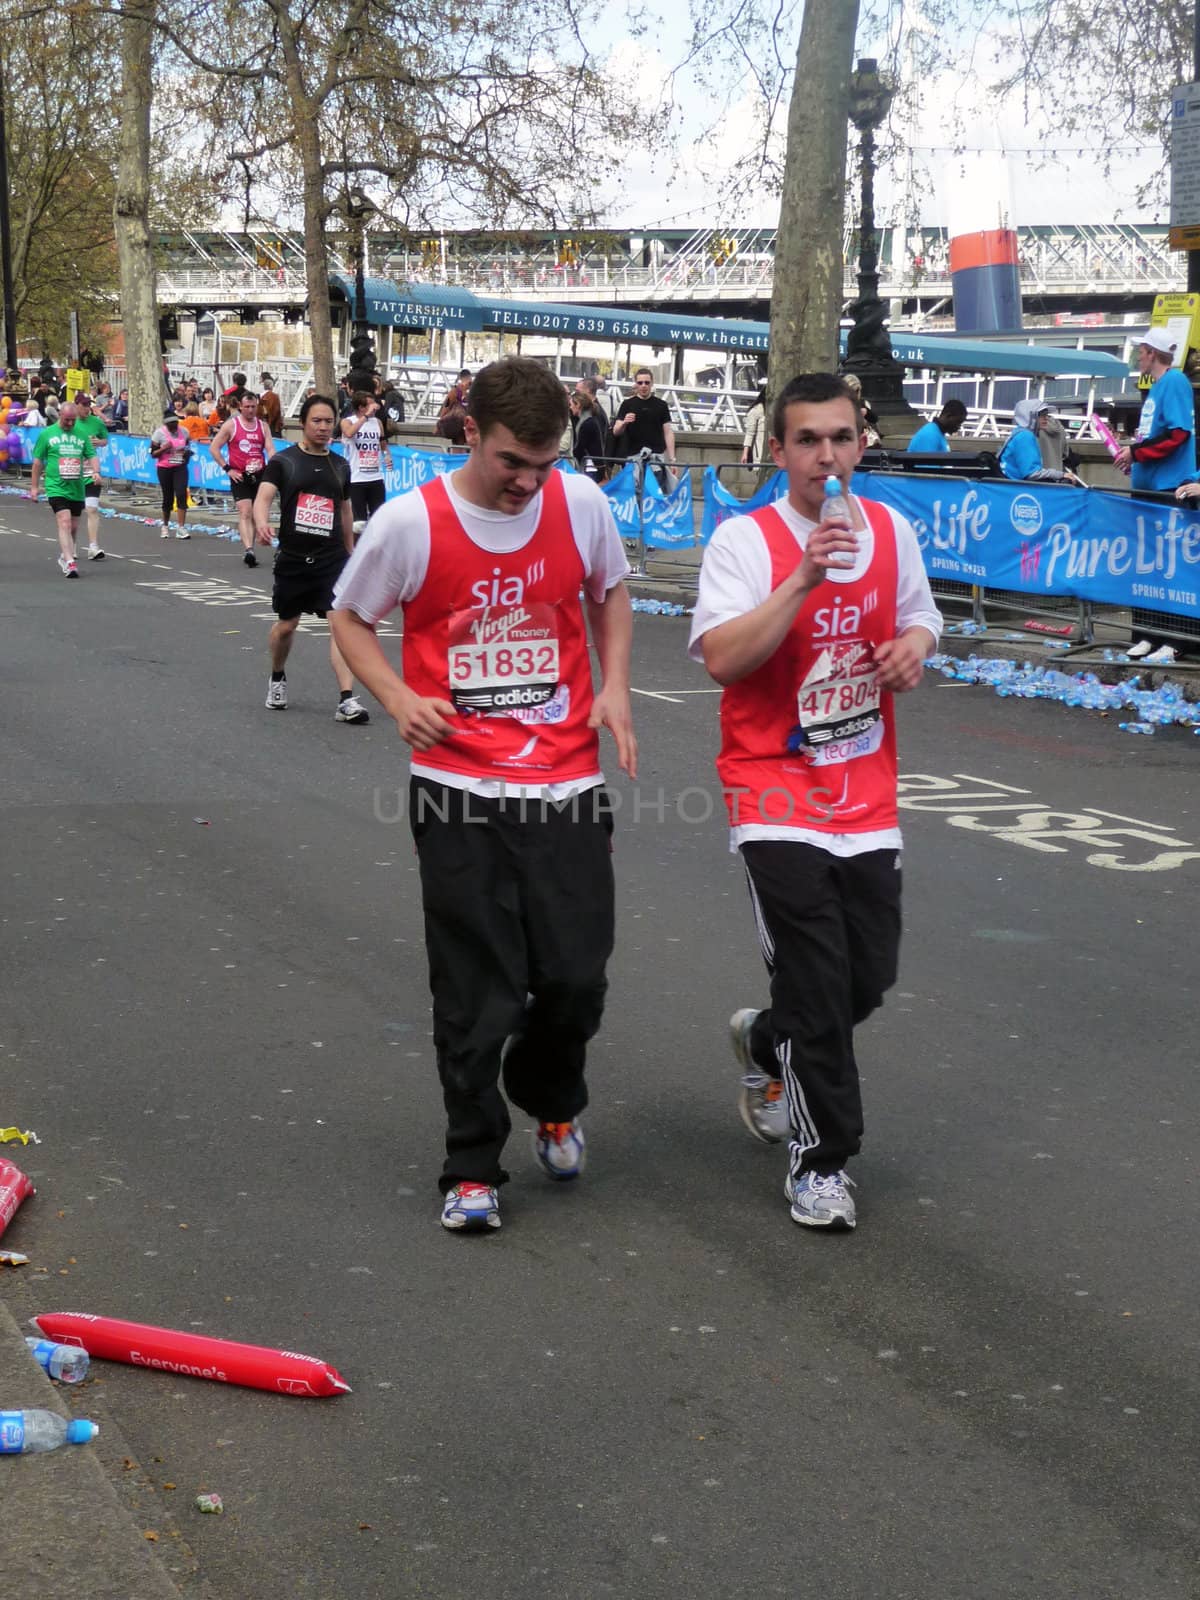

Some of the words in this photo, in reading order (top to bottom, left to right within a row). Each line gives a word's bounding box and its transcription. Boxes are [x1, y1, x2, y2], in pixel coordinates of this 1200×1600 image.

[373, 300, 465, 318] TATTERSHALL
[393, 313, 444, 327] CASTLE
[492, 310, 528, 326] TEL:
[532, 315, 570, 329] 0207
[577, 318, 605, 332] 839
[612, 322, 649, 336] 6548
[49, 433, 85, 448] MARK
[402, 452, 427, 490] Life
[932, 489, 992, 555] Life
[1046, 523, 1132, 587] Pure
[1135, 508, 1200, 580] Life
[932, 556, 960, 571] SPRING
[470, 567, 524, 609] sia
[1132, 583, 1165, 599] SPRING
[1168, 589, 1197, 606] WATER
[469, 606, 532, 645] Virgin
[811, 596, 861, 638] sia
[511, 628, 550, 638] money
[453, 646, 556, 681] 51832
[493, 688, 551, 706] adidas
[801, 681, 878, 717] 47804
[833, 716, 877, 738] adidas
[130, 1350, 228, 1381] Everyone's
[281, 1350, 326, 1366] money
